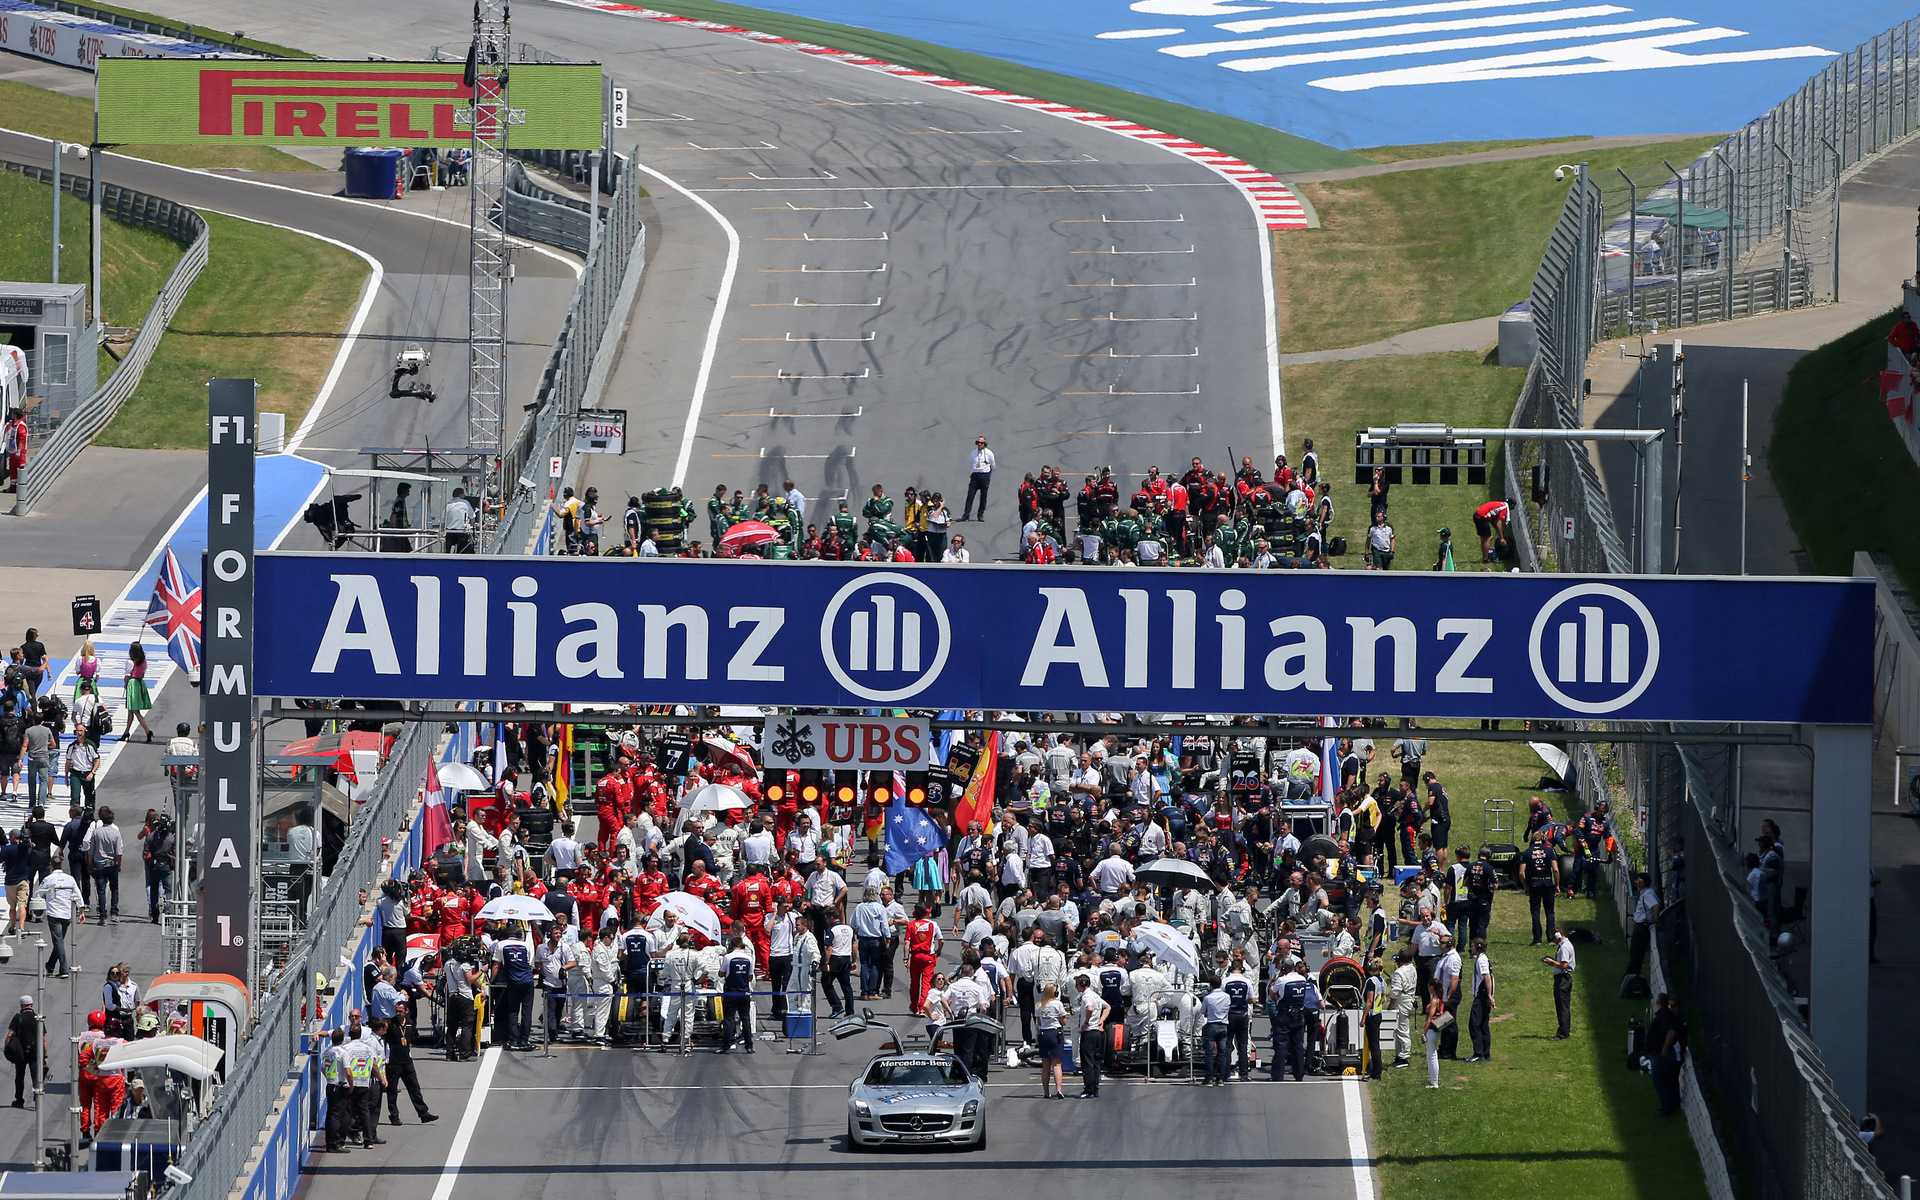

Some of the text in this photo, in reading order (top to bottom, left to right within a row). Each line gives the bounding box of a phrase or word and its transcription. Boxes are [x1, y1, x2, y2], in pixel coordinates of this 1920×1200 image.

[39, 26, 56, 56] UBS
[199, 70, 502, 139] PIRELLI
[615, 90, 623, 126] DRS
[593, 424, 622, 438] UBS
[552, 460, 560, 474] F
[310, 573, 786, 682] Allianz
[1018, 586, 1494, 694] Allianz
[821, 722, 921, 764] UBS
[665, 749, 684, 770] 7
[1232, 769, 1260, 791] 26
[880, 1060, 953, 1068] Mercedes-Benz
